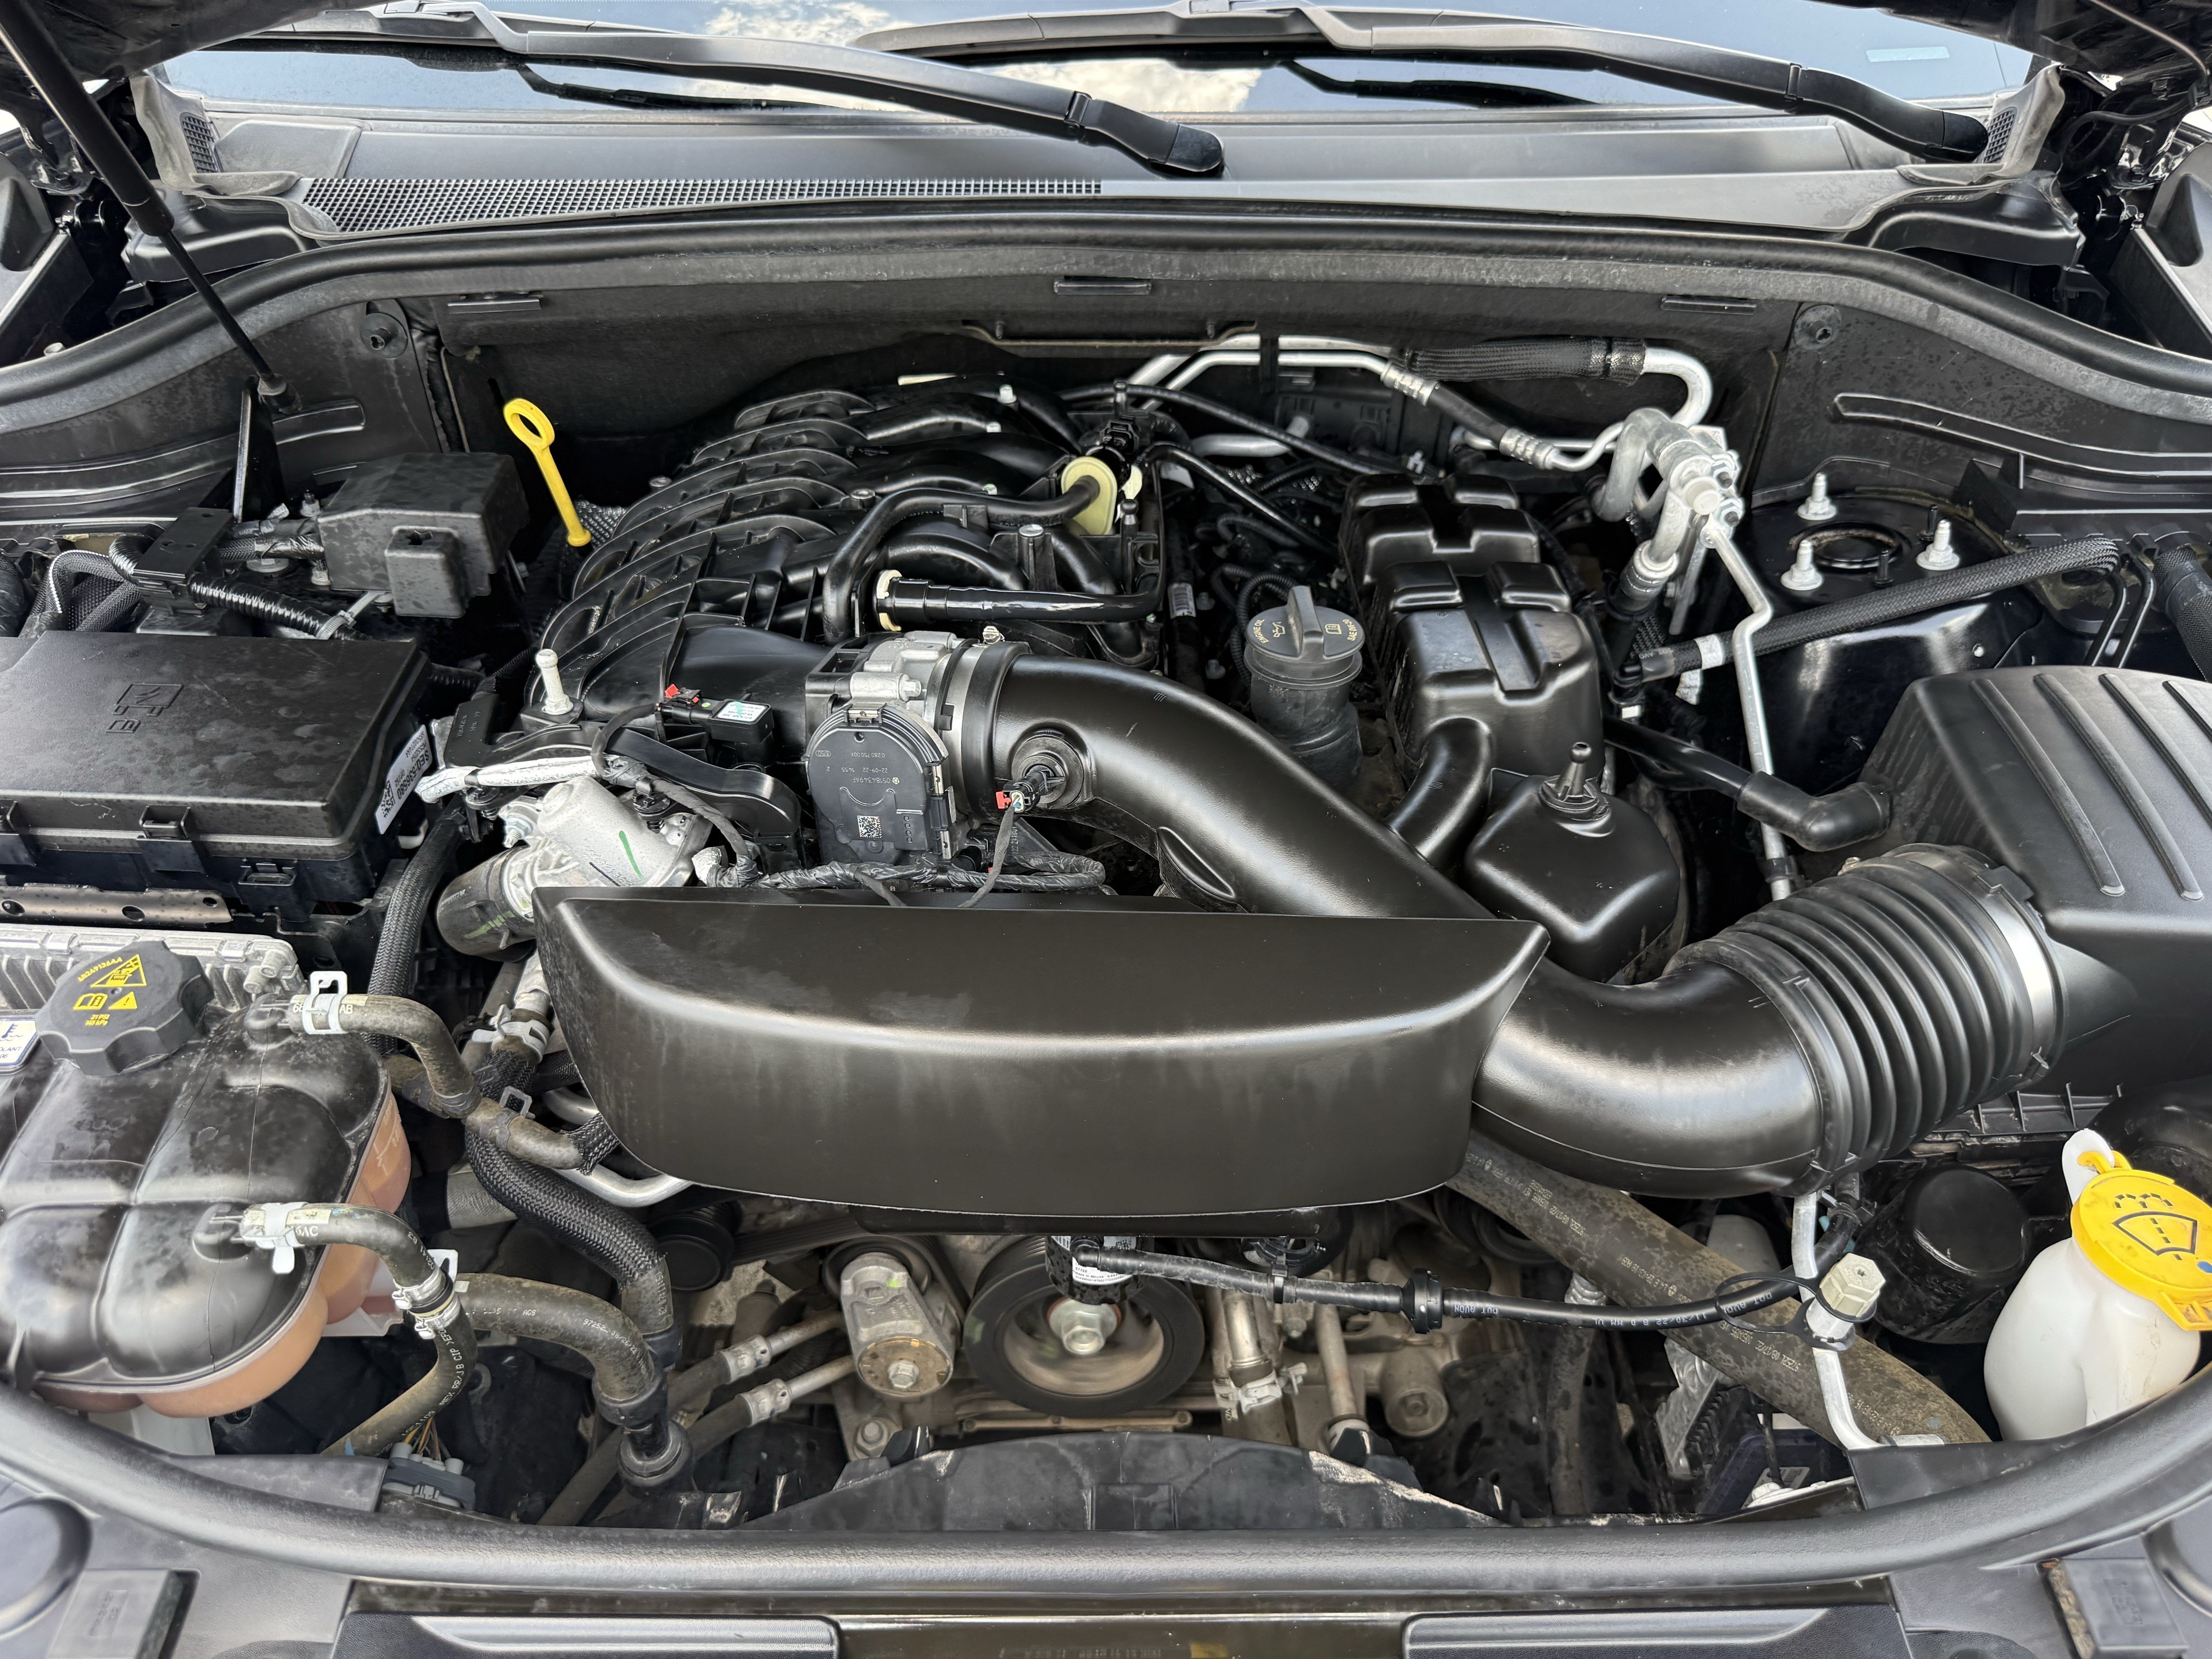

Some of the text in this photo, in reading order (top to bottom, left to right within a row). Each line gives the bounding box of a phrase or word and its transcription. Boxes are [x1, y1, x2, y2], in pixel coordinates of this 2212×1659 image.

[1253, 627, 1269, 643] ENGINE
[1347, 631, 1357, 641] SAE
[1454, 1304, 1475, 1314] AVON
